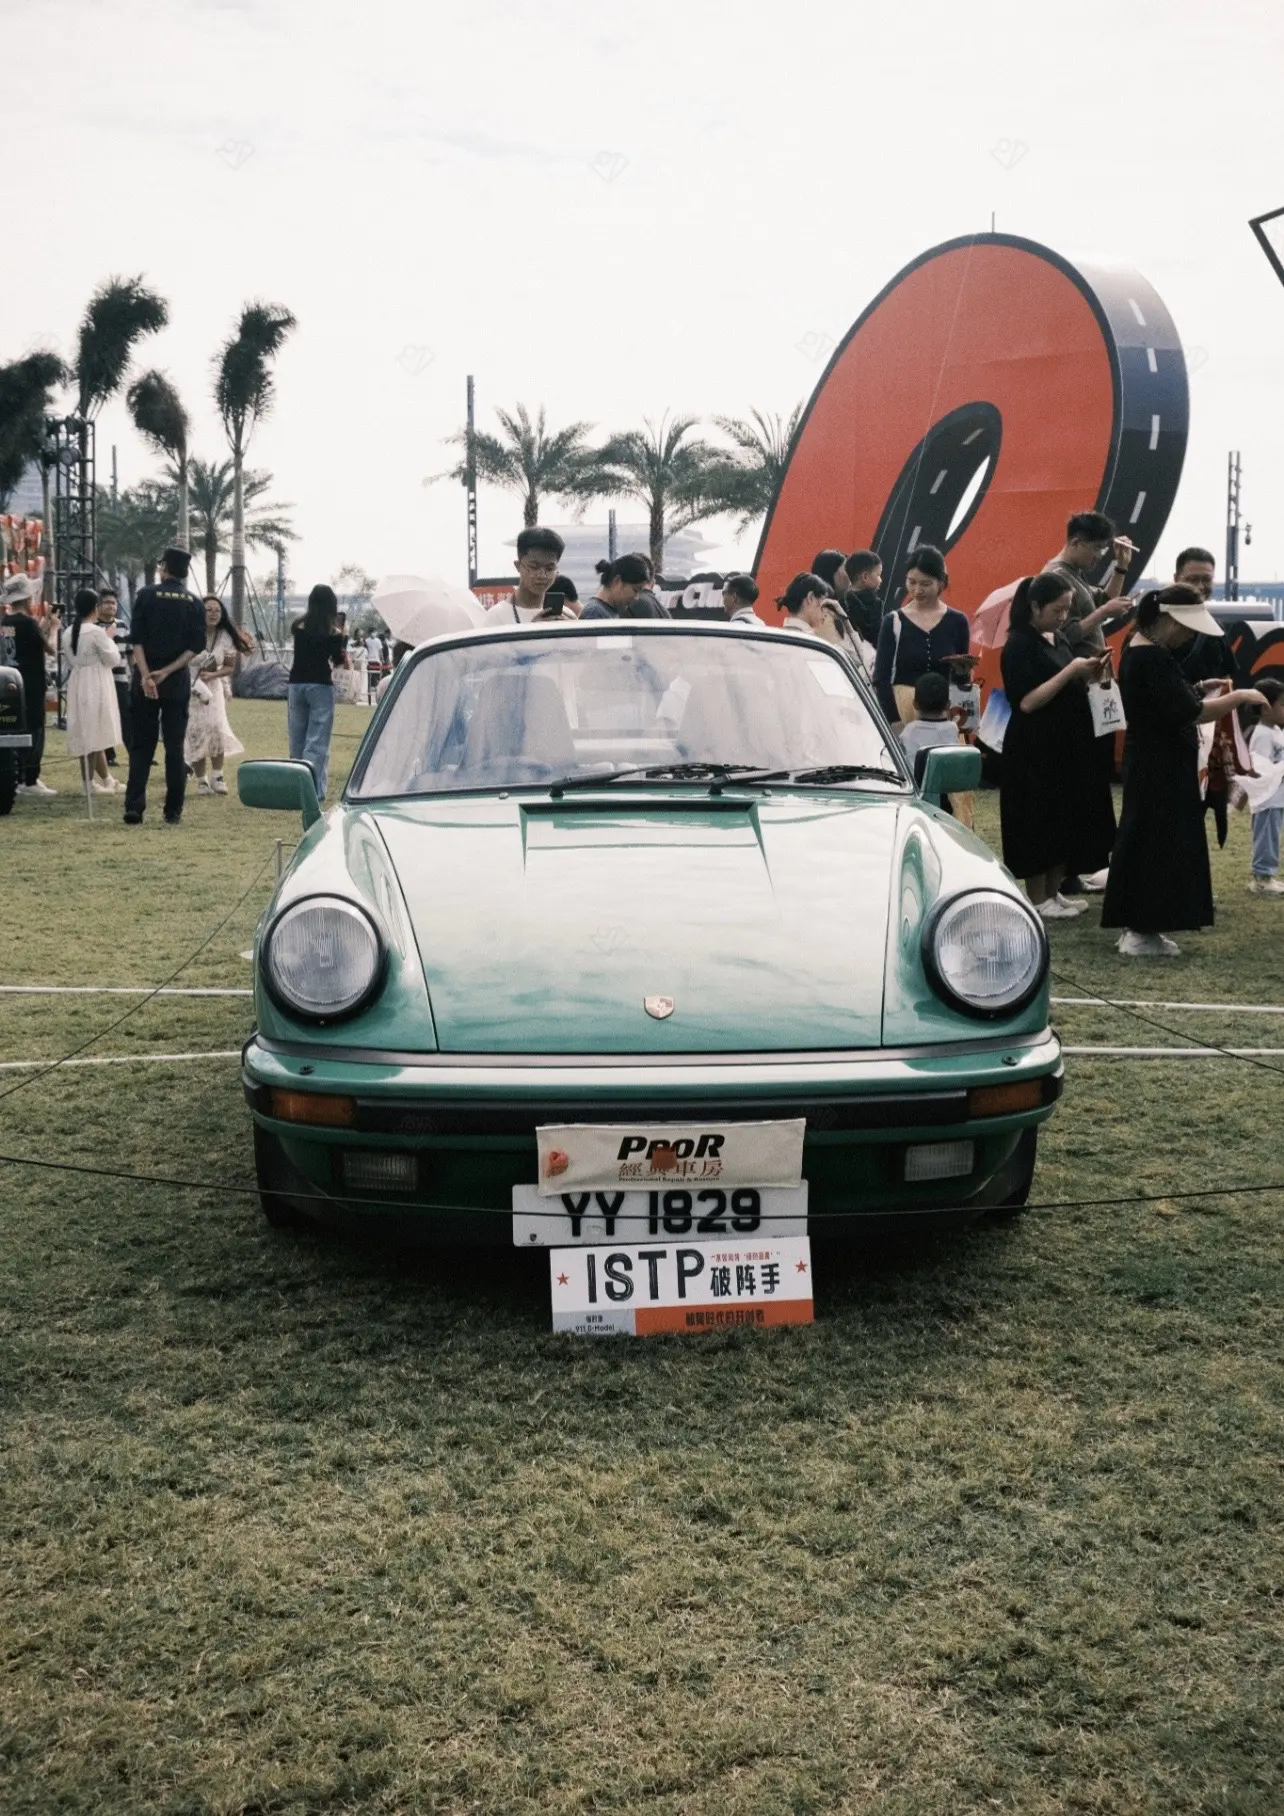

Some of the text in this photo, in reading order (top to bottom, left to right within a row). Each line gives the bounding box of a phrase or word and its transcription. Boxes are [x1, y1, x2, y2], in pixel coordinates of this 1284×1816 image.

[561, 1188, 761, 1238] YY 1829
[586, 1248, 781, 1303] ISTP 破阵手
